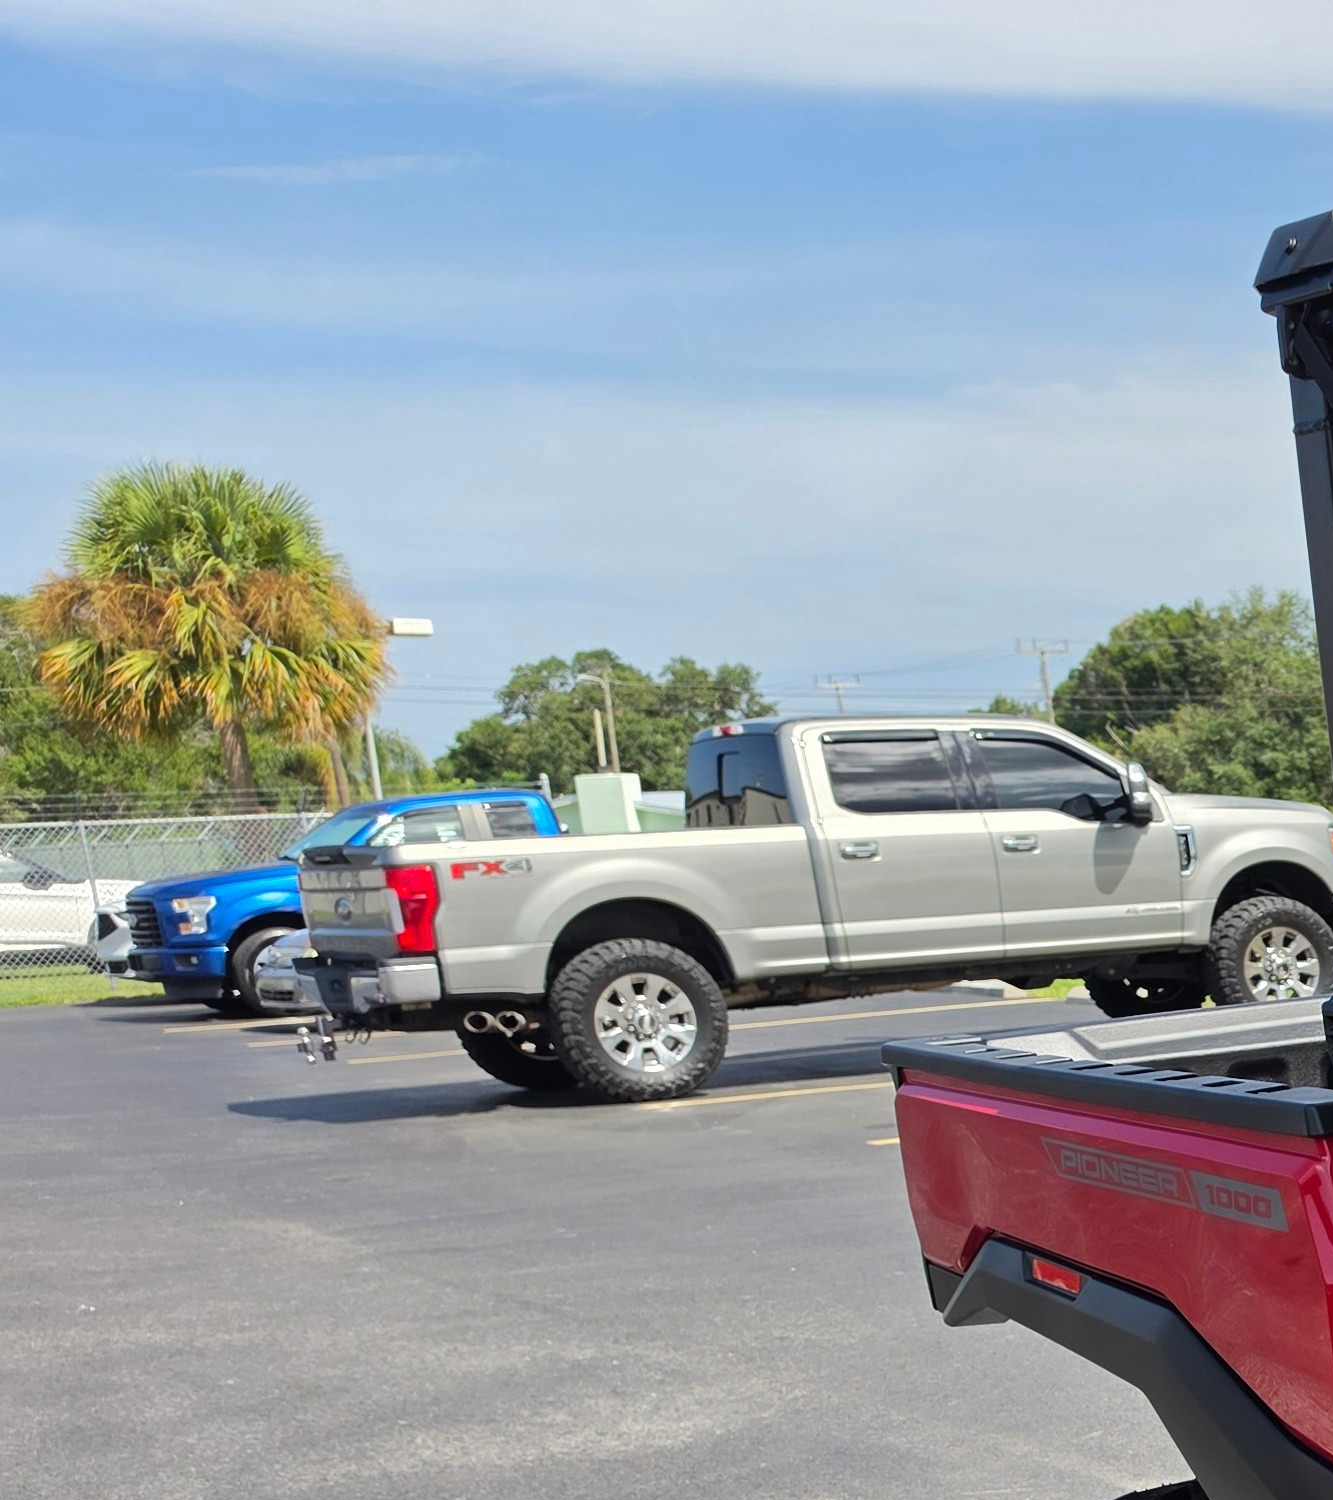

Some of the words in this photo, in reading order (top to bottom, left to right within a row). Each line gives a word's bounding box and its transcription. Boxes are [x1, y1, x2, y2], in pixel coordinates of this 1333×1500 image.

[450, 858, 533, 880] FX4
[1060, 1149, 1179, 1197] PIONEER
[1206, 1184, 1272, 1219] 1000
